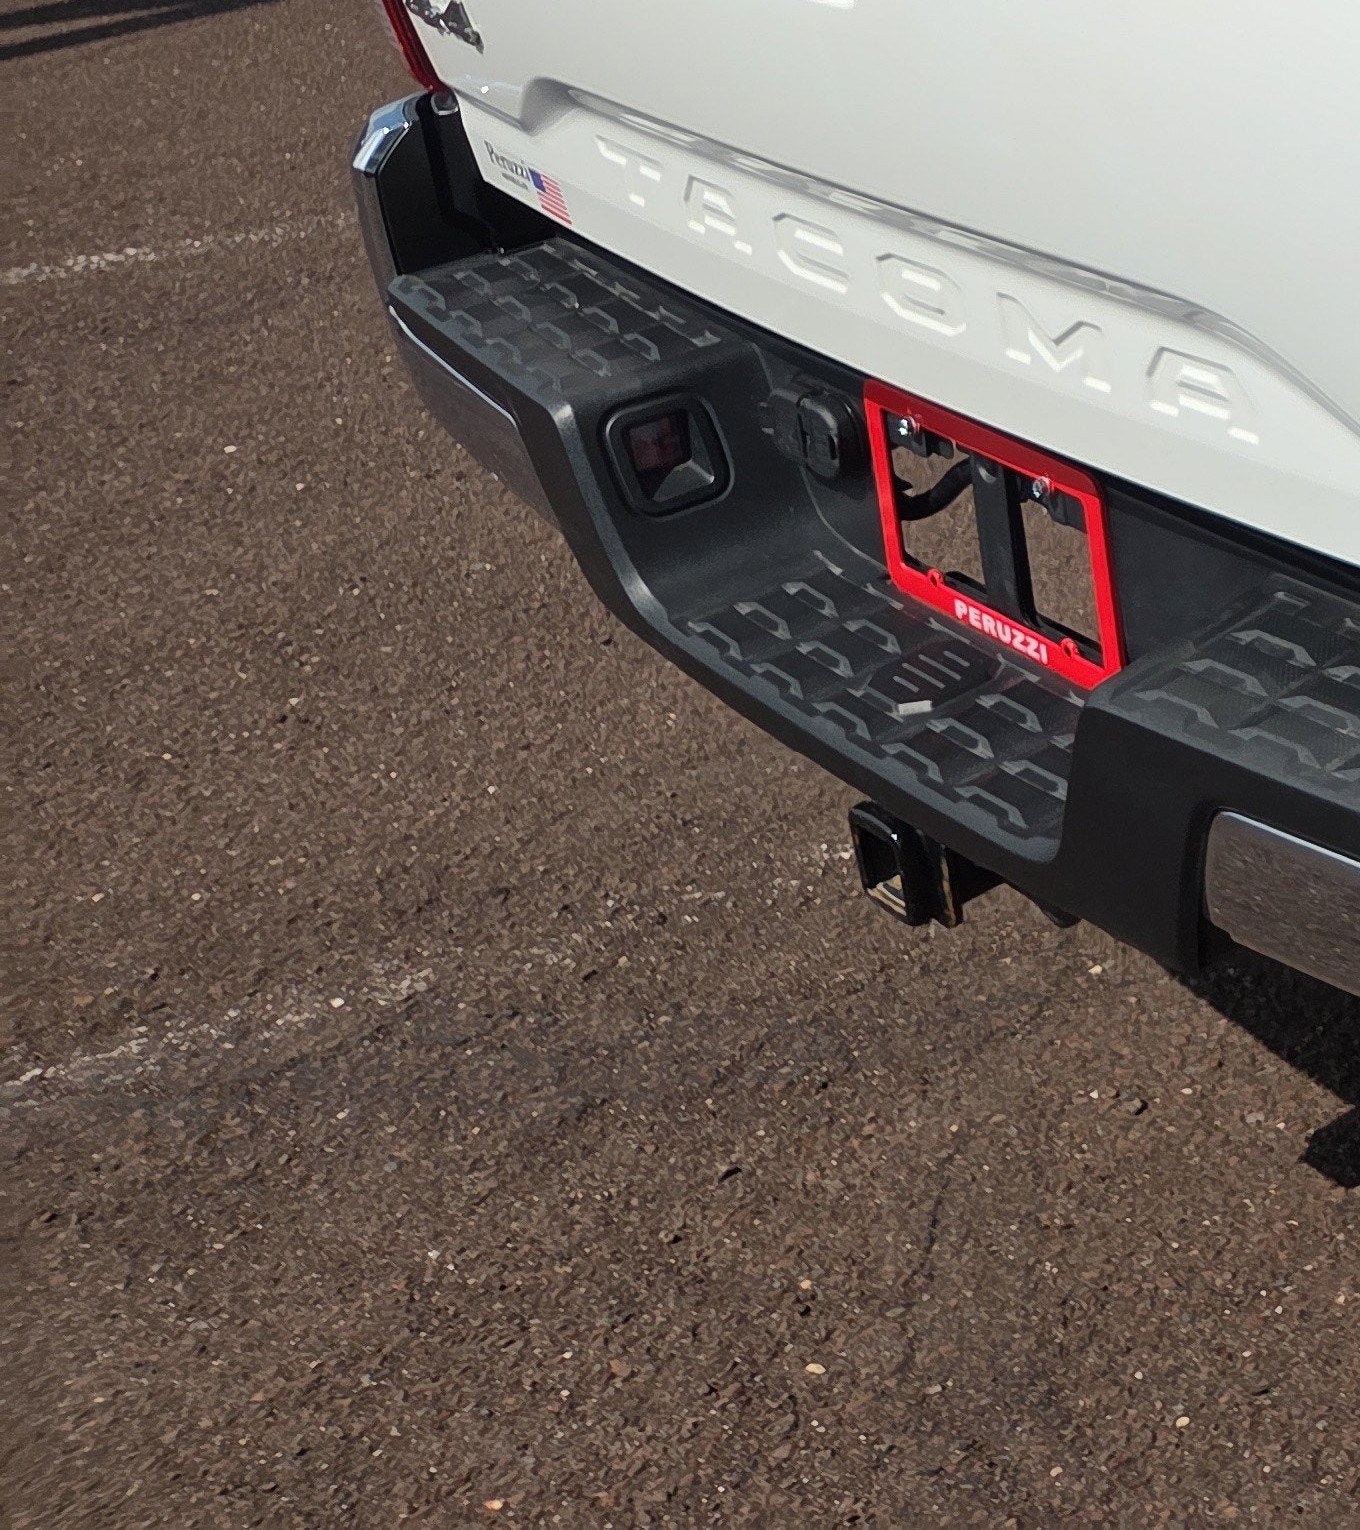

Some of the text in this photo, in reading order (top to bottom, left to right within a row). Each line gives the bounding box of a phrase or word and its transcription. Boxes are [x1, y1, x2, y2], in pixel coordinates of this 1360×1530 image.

[483, 139, 531, 182] Peruzzi
[595, 134, 1262, 446] TACOMA
[954, 598, 1049, 665] PERUZZI
